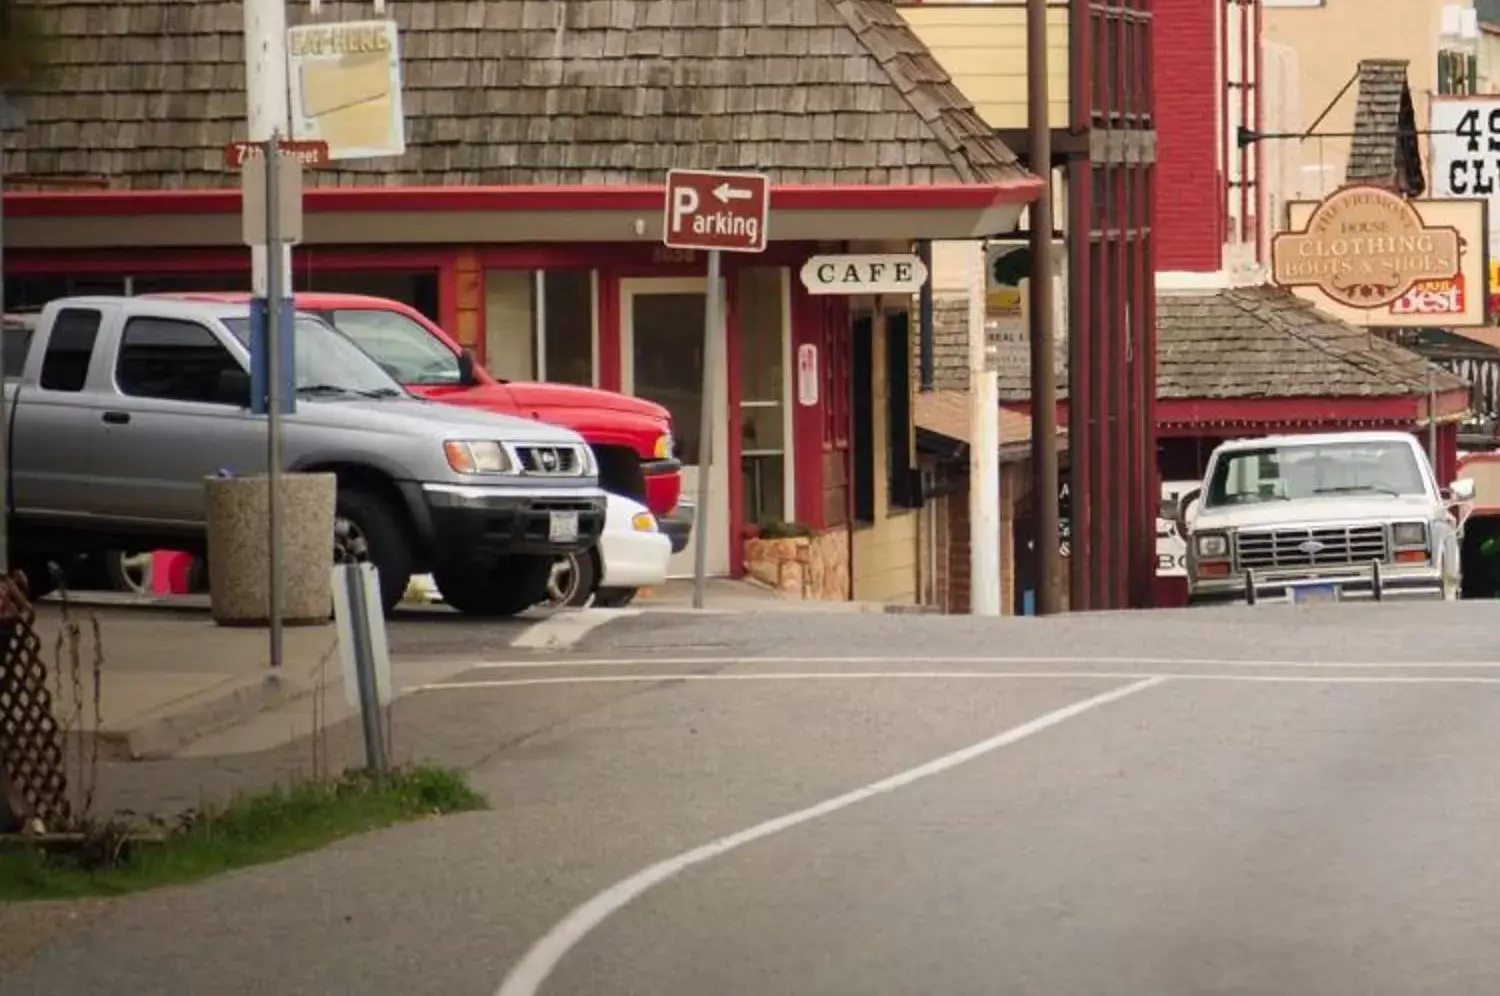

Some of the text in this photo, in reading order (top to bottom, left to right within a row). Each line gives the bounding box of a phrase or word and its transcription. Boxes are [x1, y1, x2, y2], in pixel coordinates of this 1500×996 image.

[672, 186, 757, 244] Parking
[1300, 234, 1433, 257] CLOTHING
[817, 262, 914, 284] CAFE
[1285, 258, 1352, 276] BOOTS
[1383, 254, 1450, 274] SHOES
